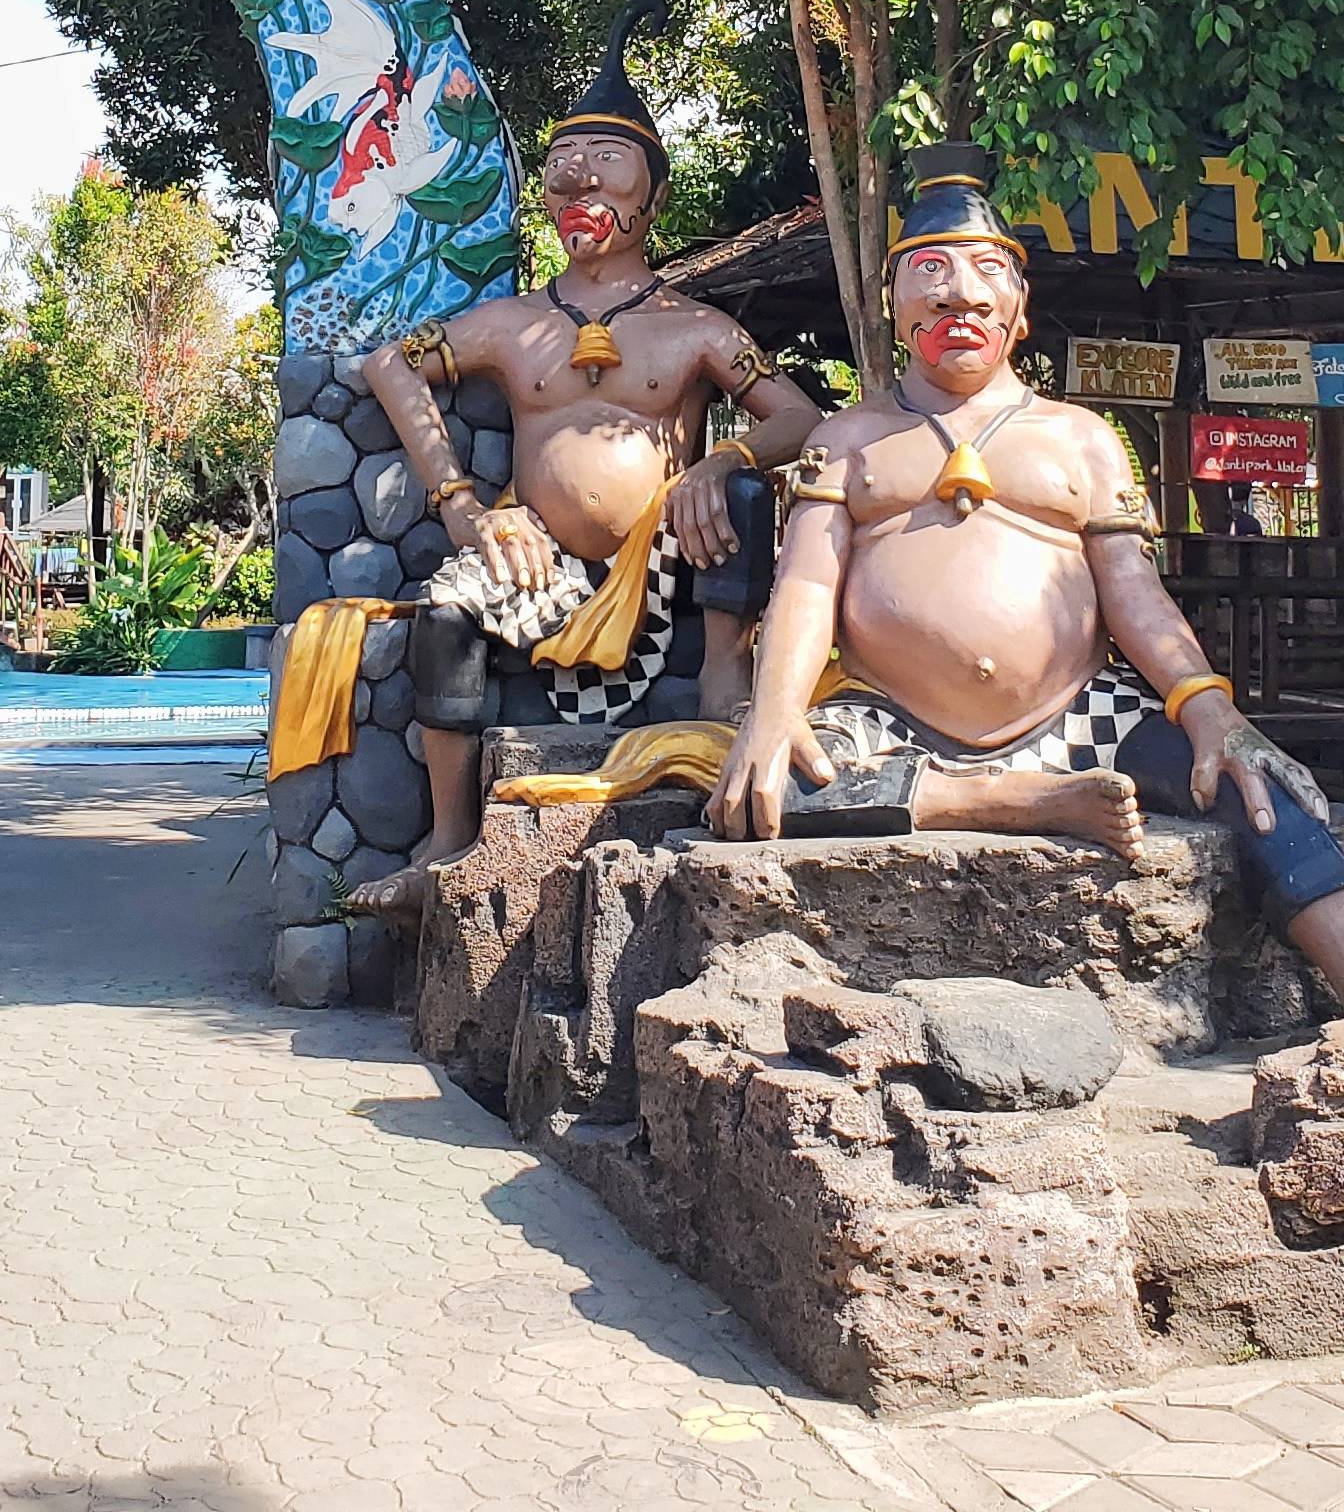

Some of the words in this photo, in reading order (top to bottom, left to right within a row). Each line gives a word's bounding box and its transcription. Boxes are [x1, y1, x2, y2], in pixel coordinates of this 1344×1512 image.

[1077, 344, 1174, 374] EXPLORE
[1221, 343, 1249, 358] ALL
[1081, 369, 1172, 397] KLATEN
[1225, 432, 1297, 448] INSTAGRAM
